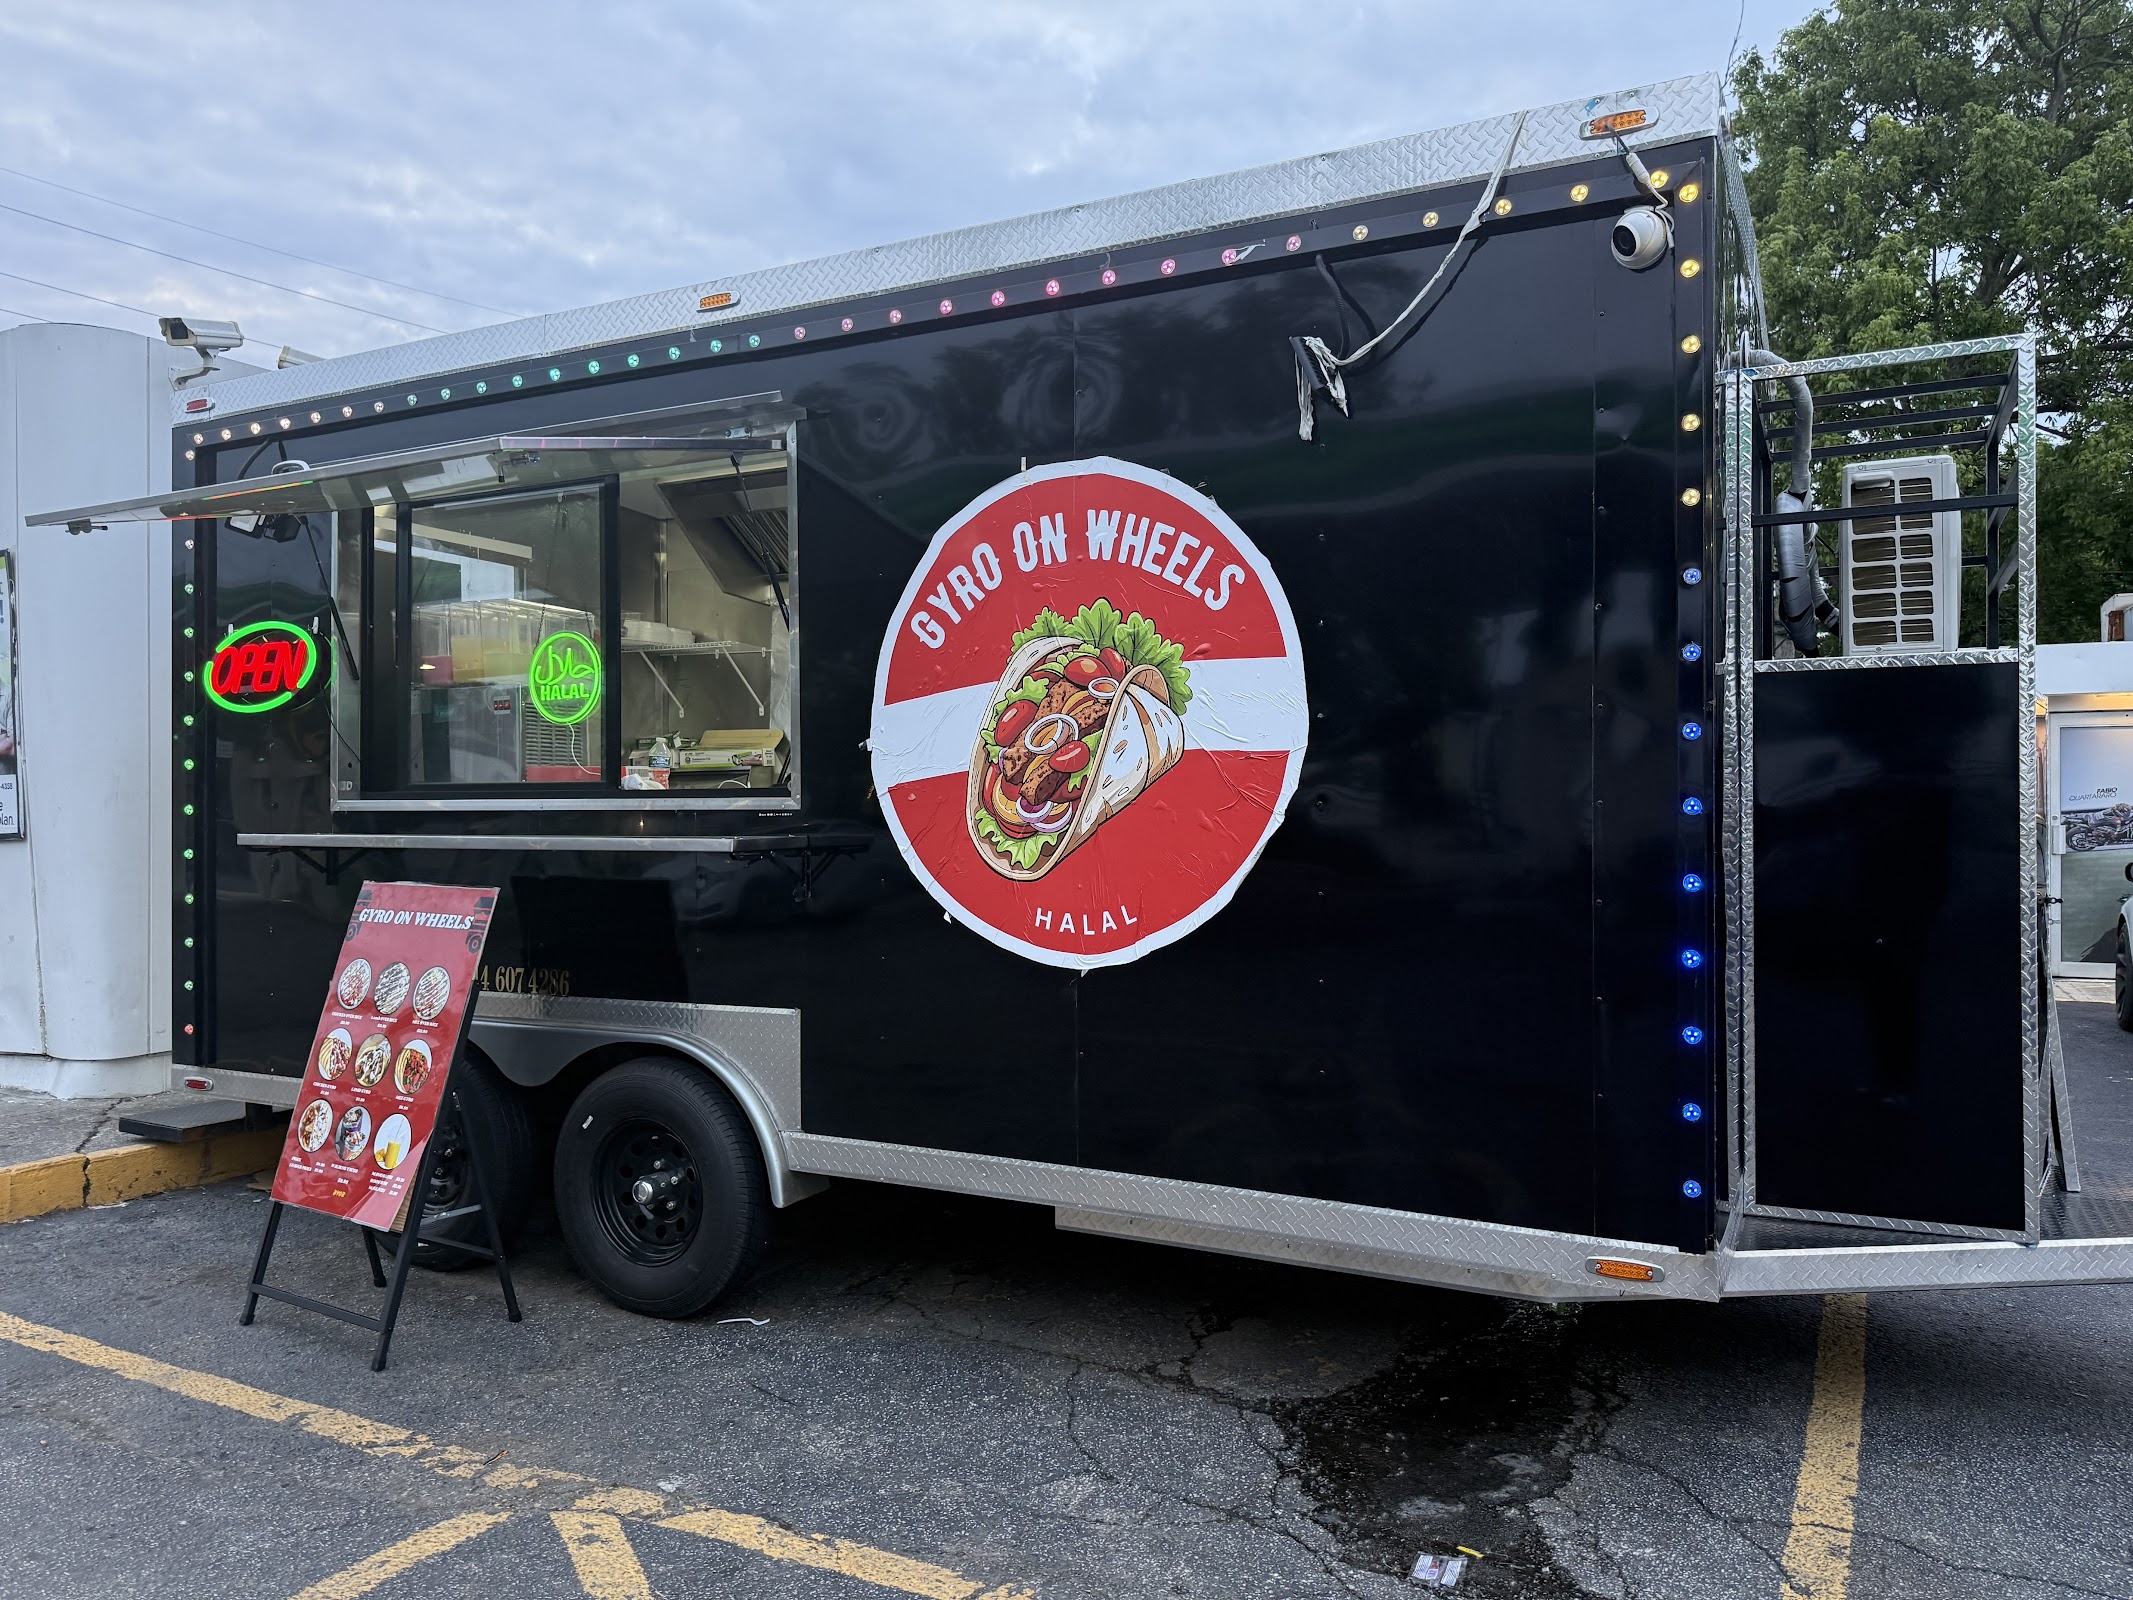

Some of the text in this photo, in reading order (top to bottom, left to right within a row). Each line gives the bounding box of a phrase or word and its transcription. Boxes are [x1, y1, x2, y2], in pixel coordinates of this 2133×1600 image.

[911, 509, 1246, 649] GYRO ON WHEELS
[212, 639, 307, 695] OPEN
[540, 682, 590, 701] HALAL
[2069, 792, 2117, 801] QUARTARARO
[359, 908, 475, 930] GYRO ON WHEELS
[1034, 904, 1138, 935] HALAL
[495, 965, 525, 993] 607
[528, 968, 570, 997] 4286
